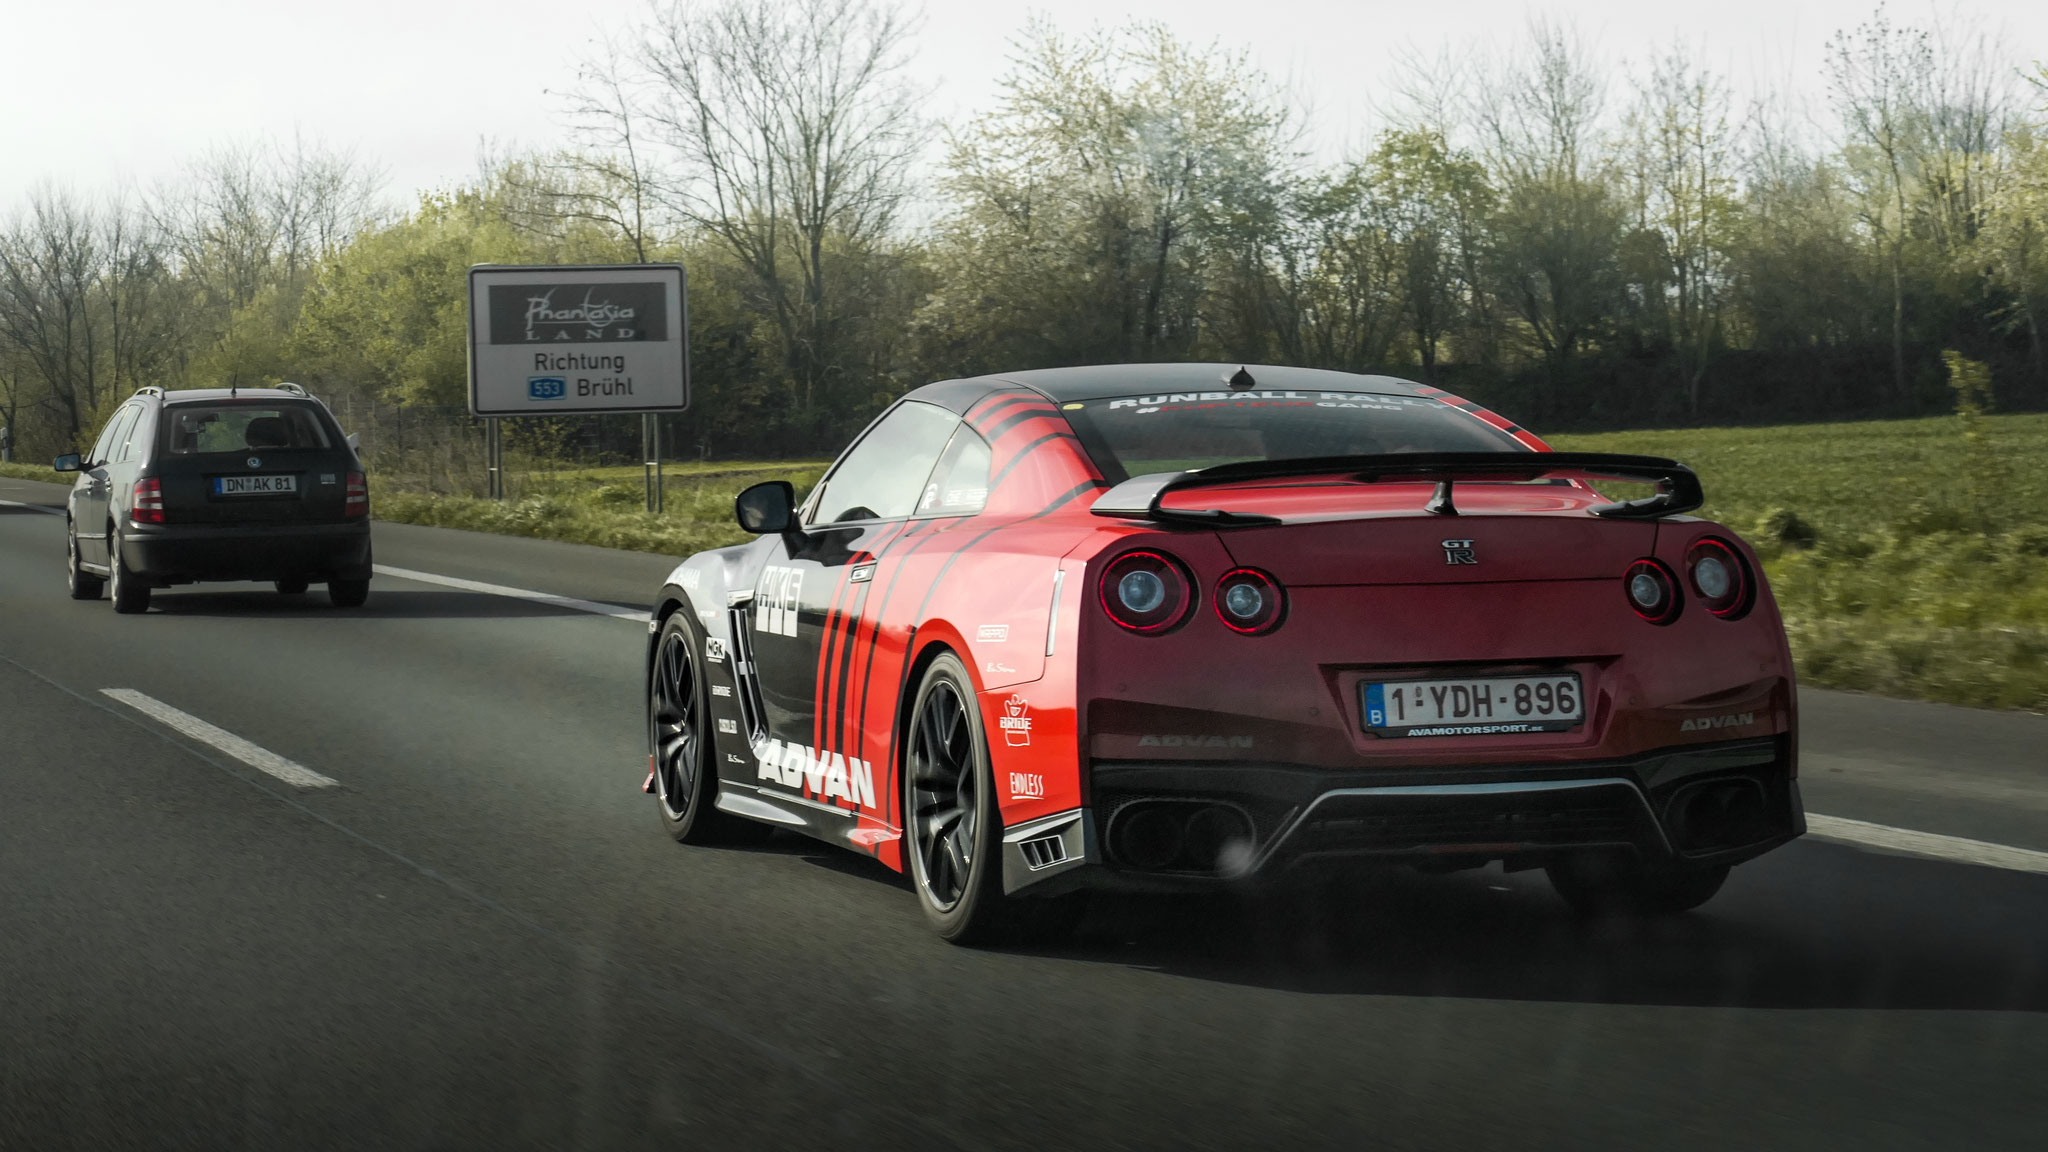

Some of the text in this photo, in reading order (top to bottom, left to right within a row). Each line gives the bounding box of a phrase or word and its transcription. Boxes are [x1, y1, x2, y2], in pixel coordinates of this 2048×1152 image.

[534, 353, 626, 374] Richtung
[534, 377, 634, 396] 553 Brühl
[1109, 391, 1450, 410] RUNBALL RALLY
[227, 477, 292, 492] DN AK 81
[1442, 539, 1475, 548] GT
[1445, 549, 1478, 564] R
[1000, 717, 1032, 729] BRIDE
[1371, 709, 1382, 724] B
[1680, 712, 1754, 731] ADVAN
[1138, 735, 1253, 747] ADVAN
[758, 738, 876, 809] ADVAN
[1010, 772, 1043, 795] ENDLESS
